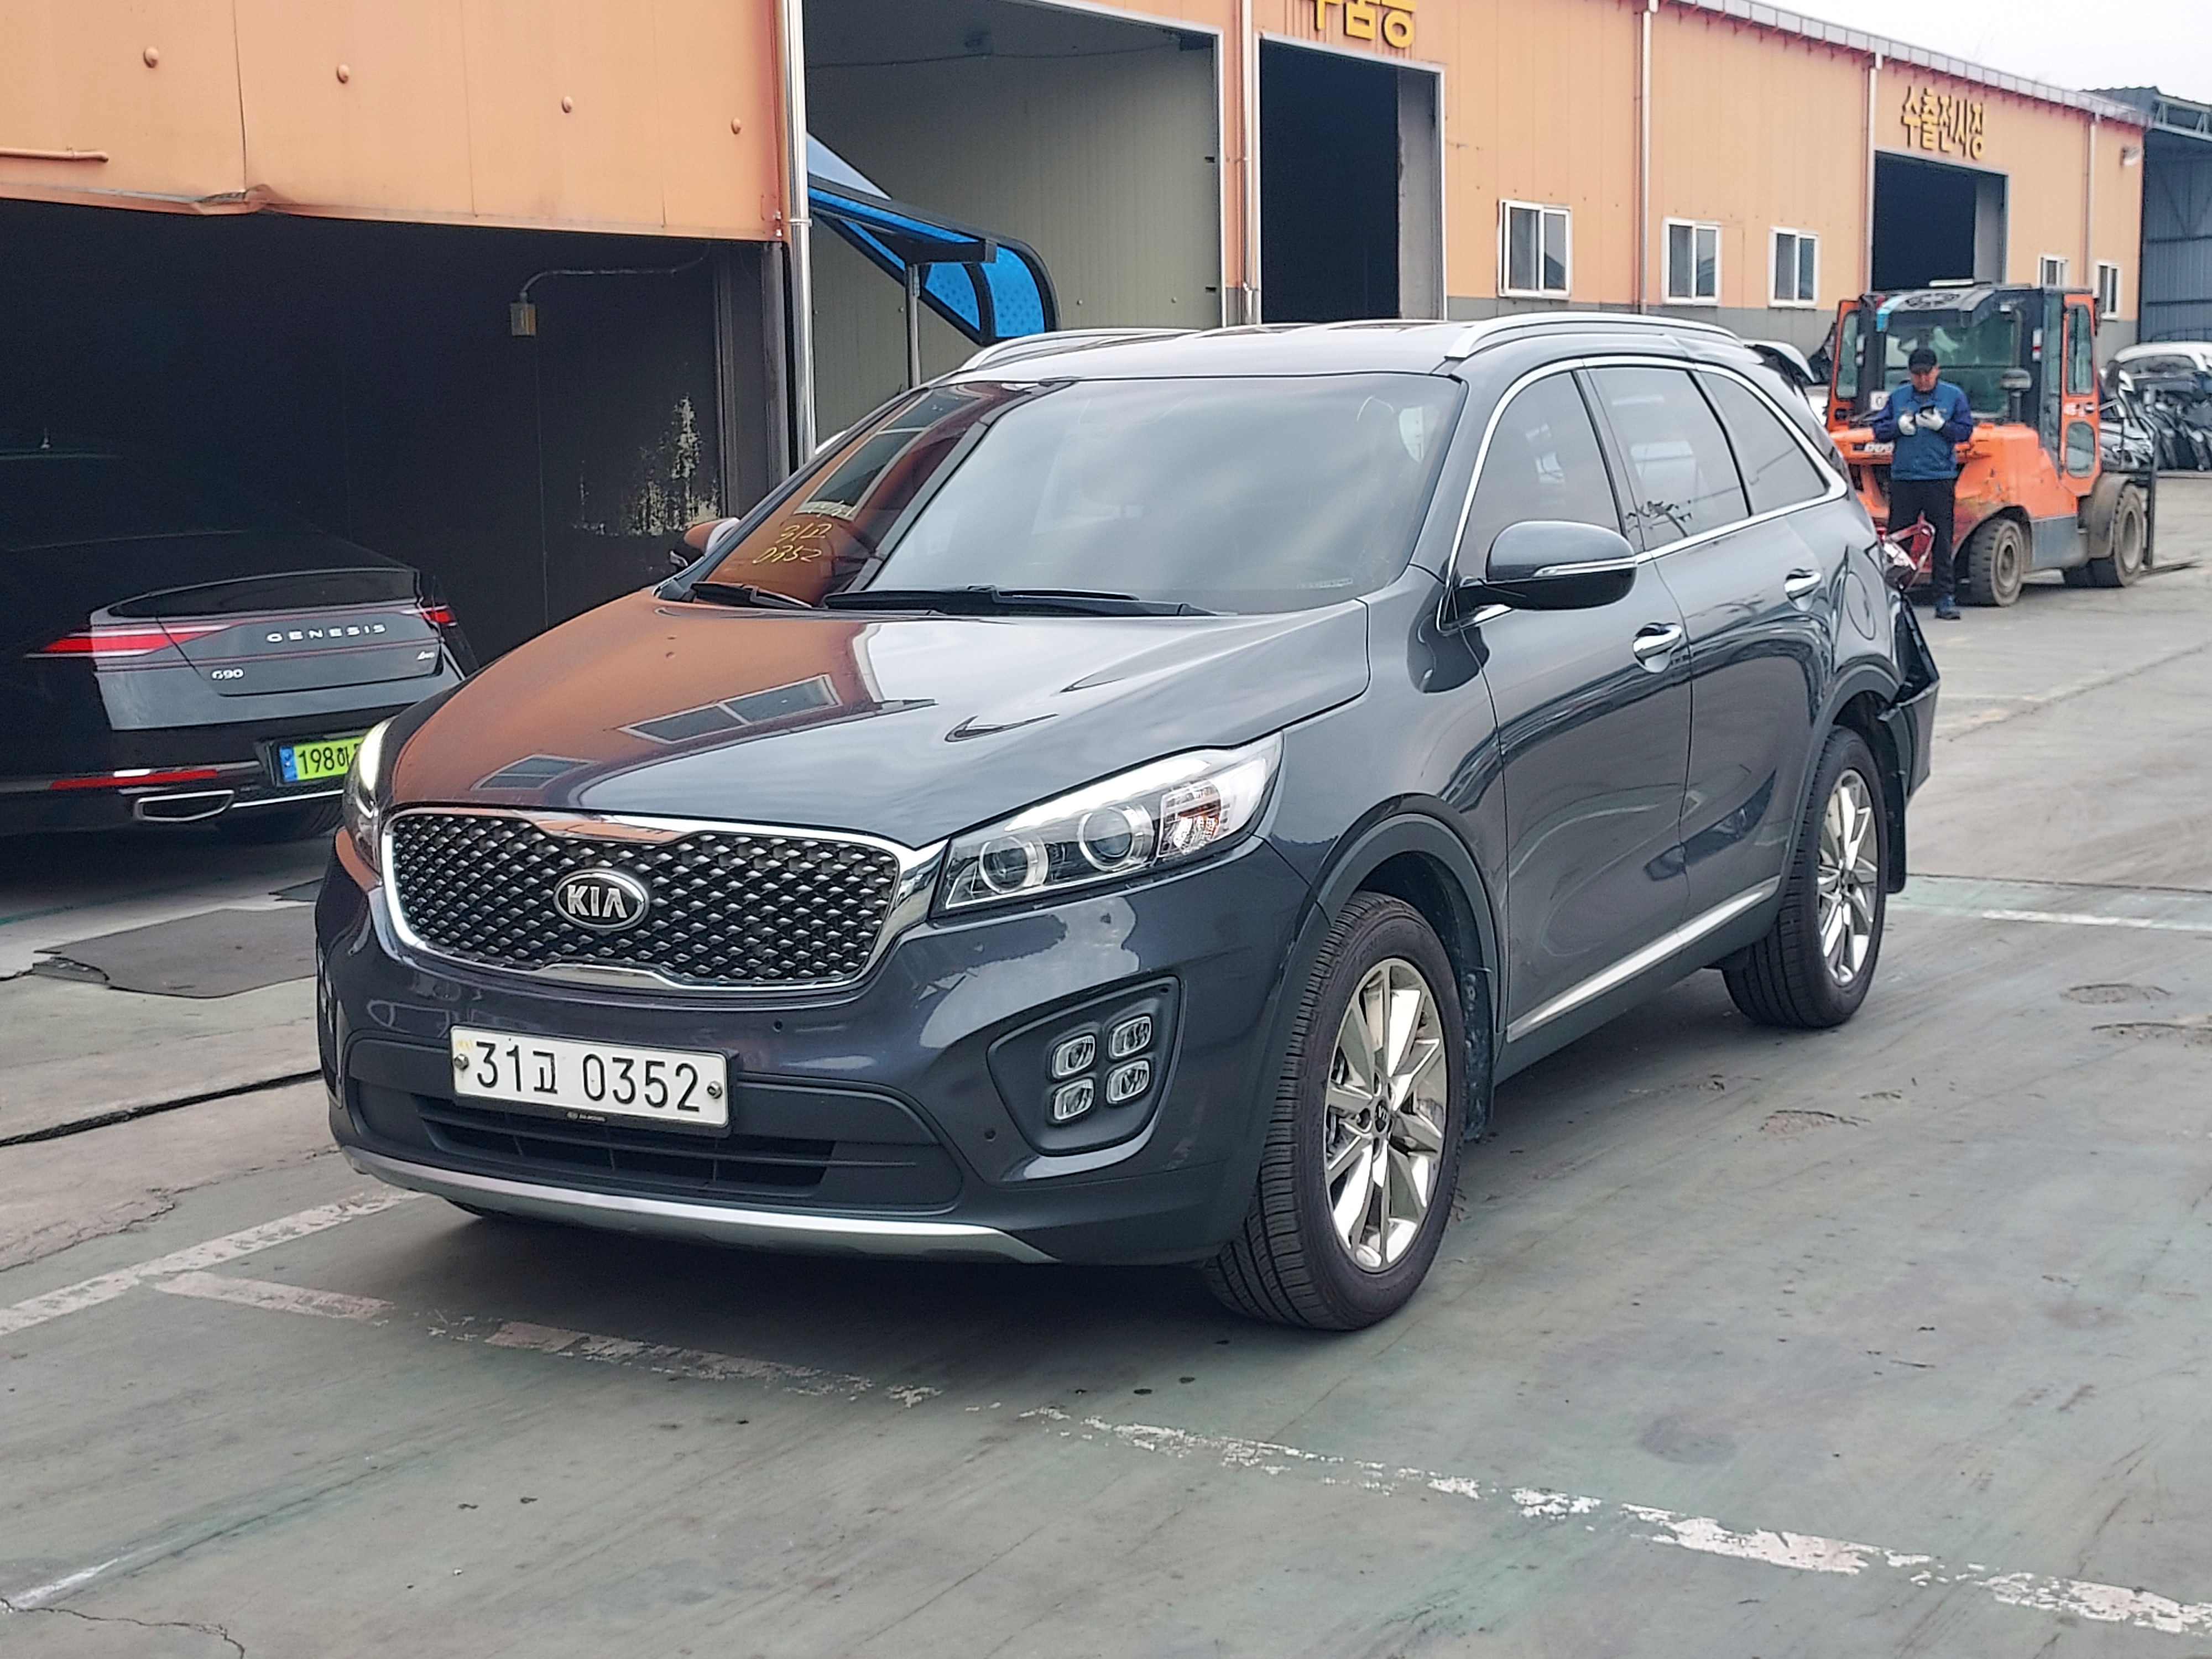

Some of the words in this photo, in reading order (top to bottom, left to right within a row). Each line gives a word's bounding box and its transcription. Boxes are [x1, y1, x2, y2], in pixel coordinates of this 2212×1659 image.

[1901, 86, 1986, 160] 수출전시장
[752, 545, 823, 564] 0352
[266, 624, 386, 643] GENESIS
[212, 669, 244, 680] G90
[567, 884, 628, 919] KIA
[476, 1041, 559, 1094] 31고
[582, 1053, 700, 1113] 0352
